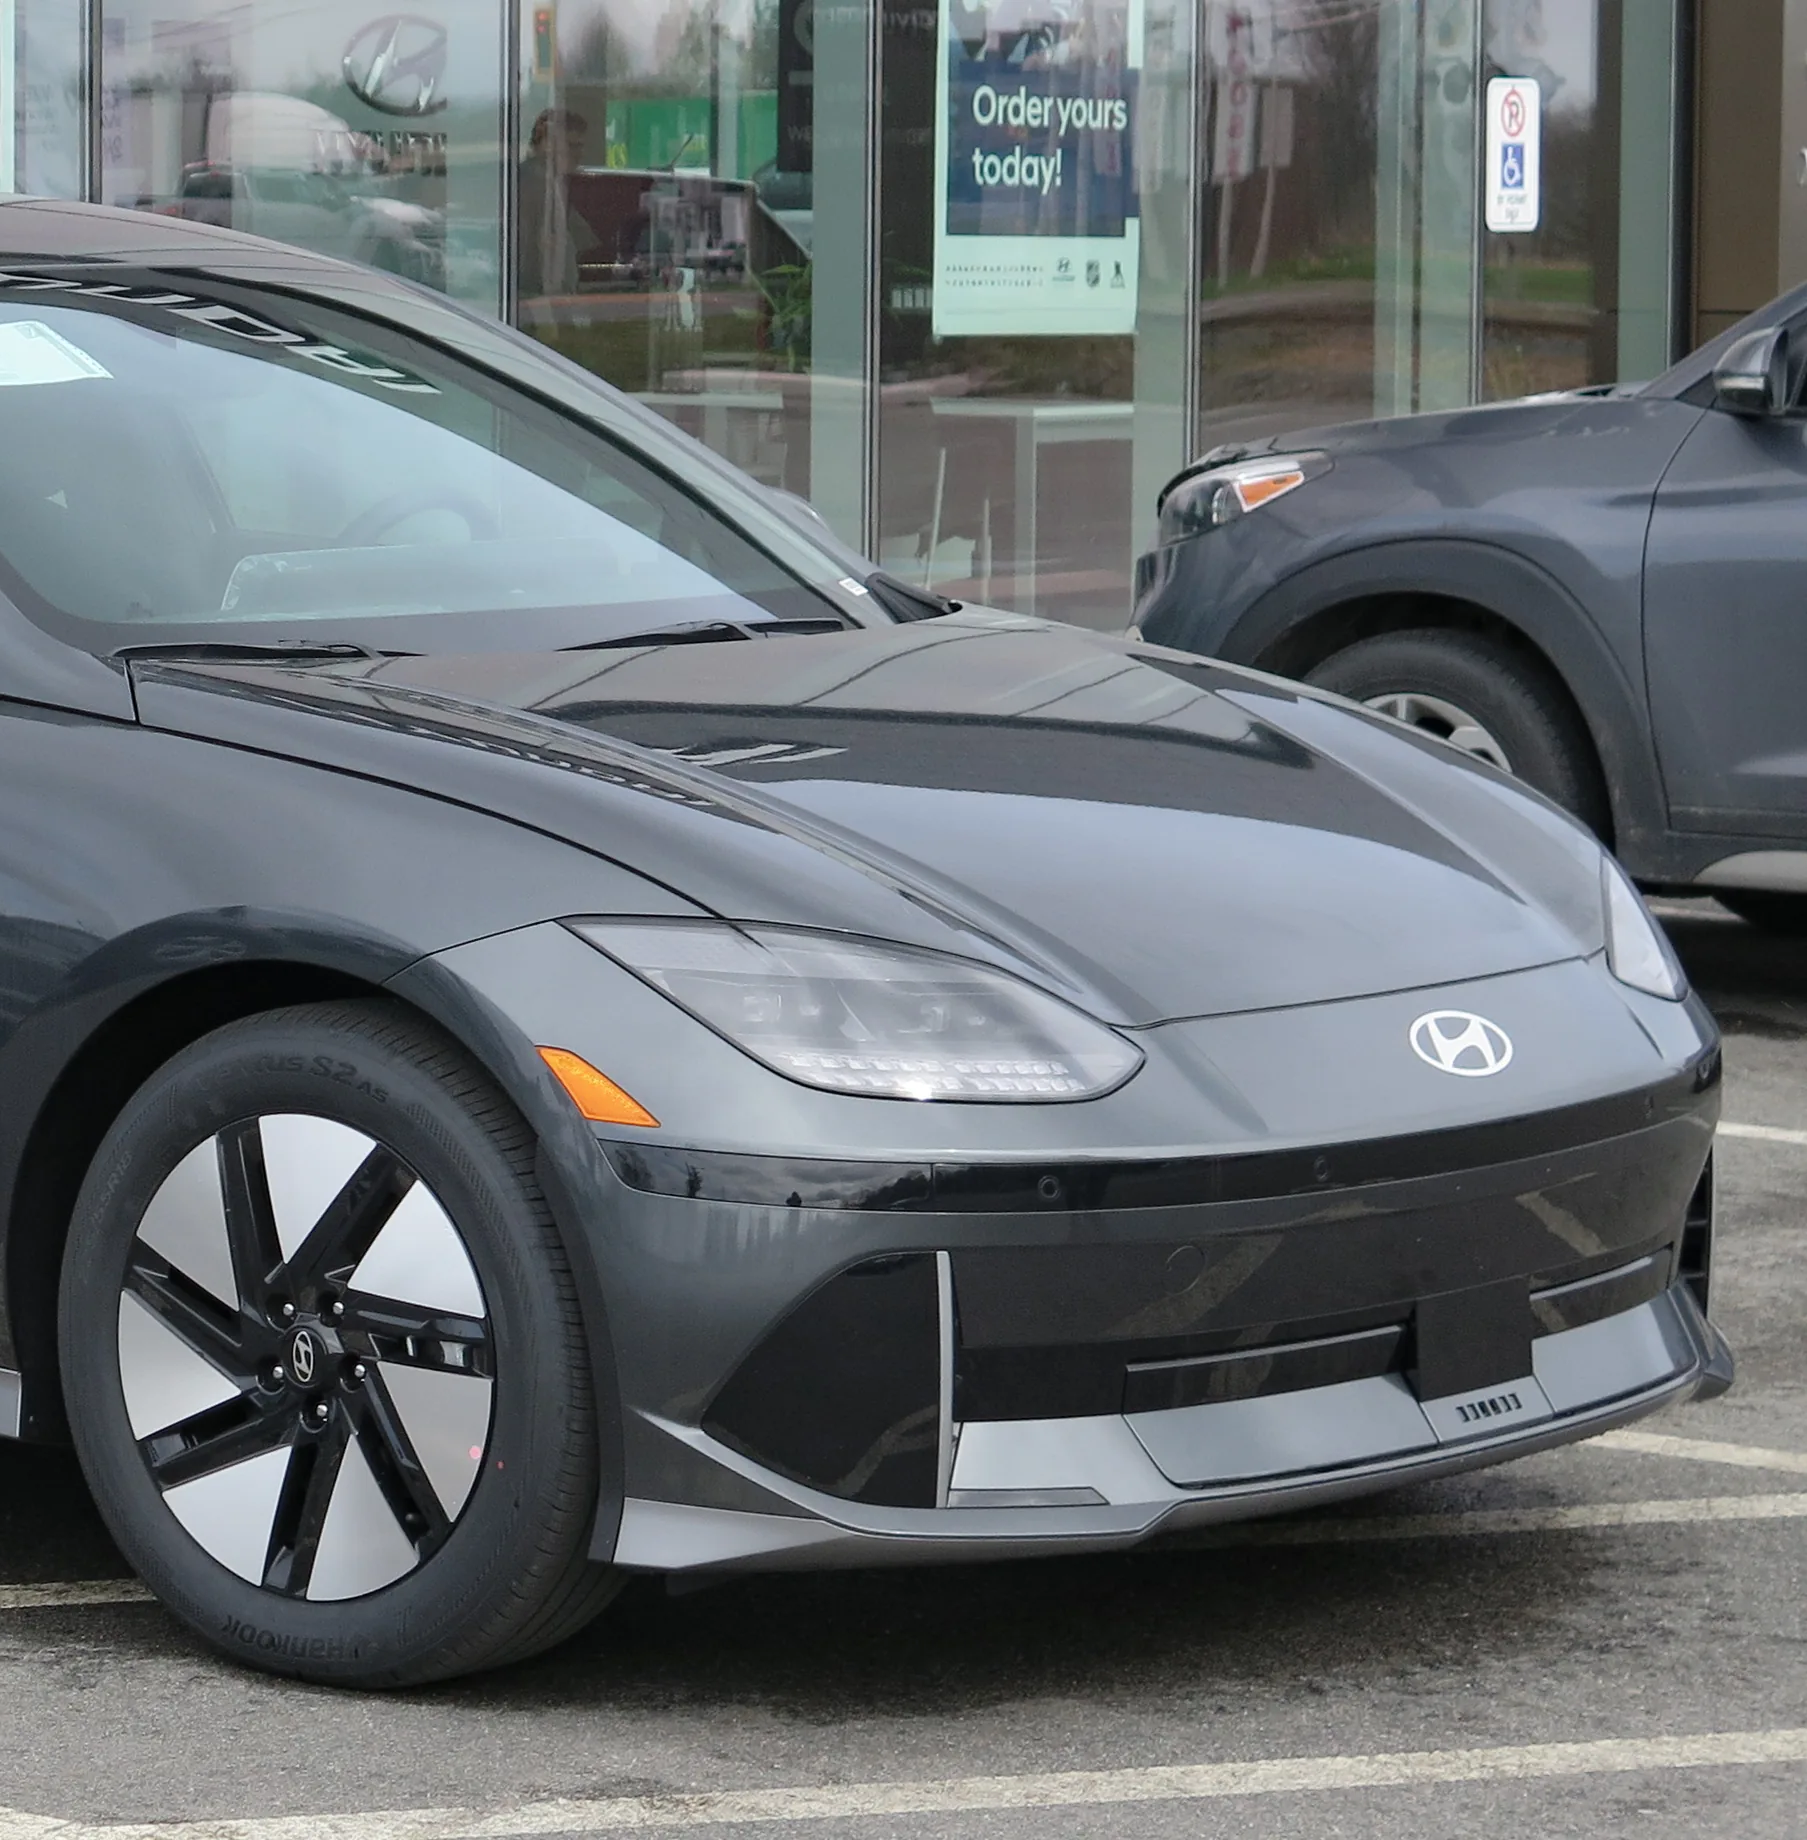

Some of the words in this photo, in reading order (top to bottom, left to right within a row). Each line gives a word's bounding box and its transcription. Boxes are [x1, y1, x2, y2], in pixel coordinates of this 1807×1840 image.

[972, 84, 1053, 126] Order
[1057, 97, 1128, 137] yours
[971, 144, 1063, 196] today!
[308, 1054, 359, 1086] S2
